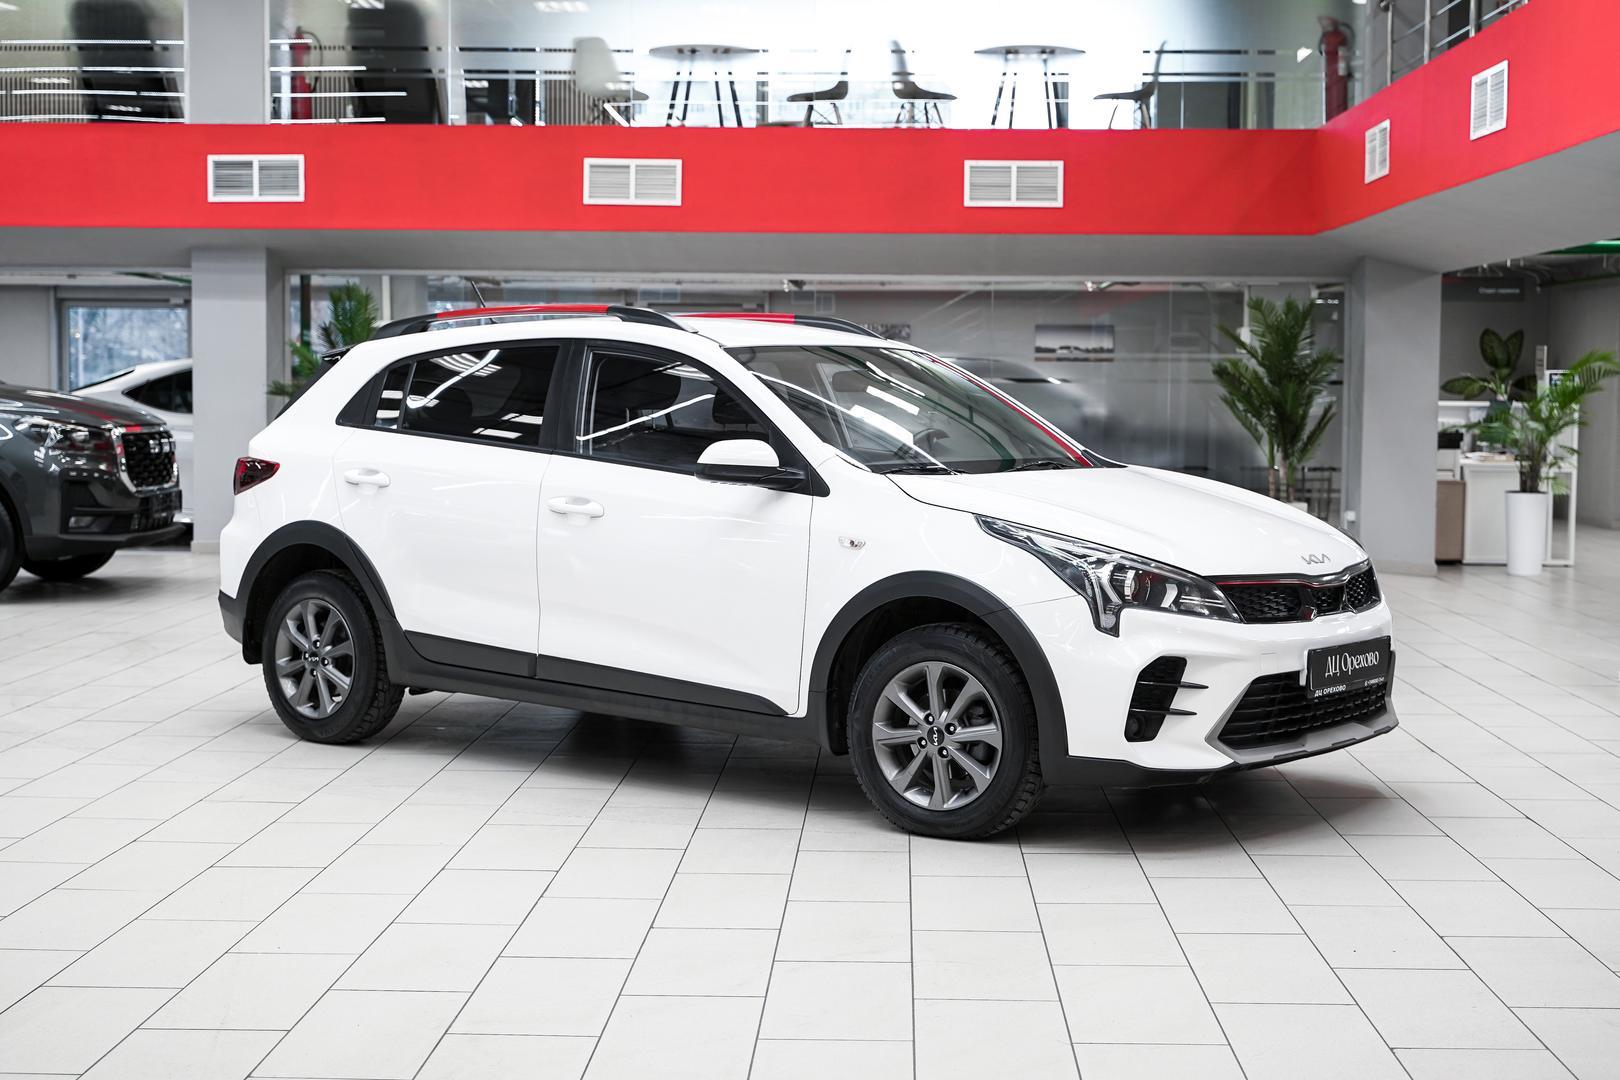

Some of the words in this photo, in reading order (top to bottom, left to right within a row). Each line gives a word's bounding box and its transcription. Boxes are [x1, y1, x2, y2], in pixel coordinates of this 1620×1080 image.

[1301, 553, 1331, 565] KIA
[1325, 654, 1340, 678] ДЦ
[1341, 651, 1380, 675] Орехово
[1323, 685, 1347, 695] ОРЕХОВО
